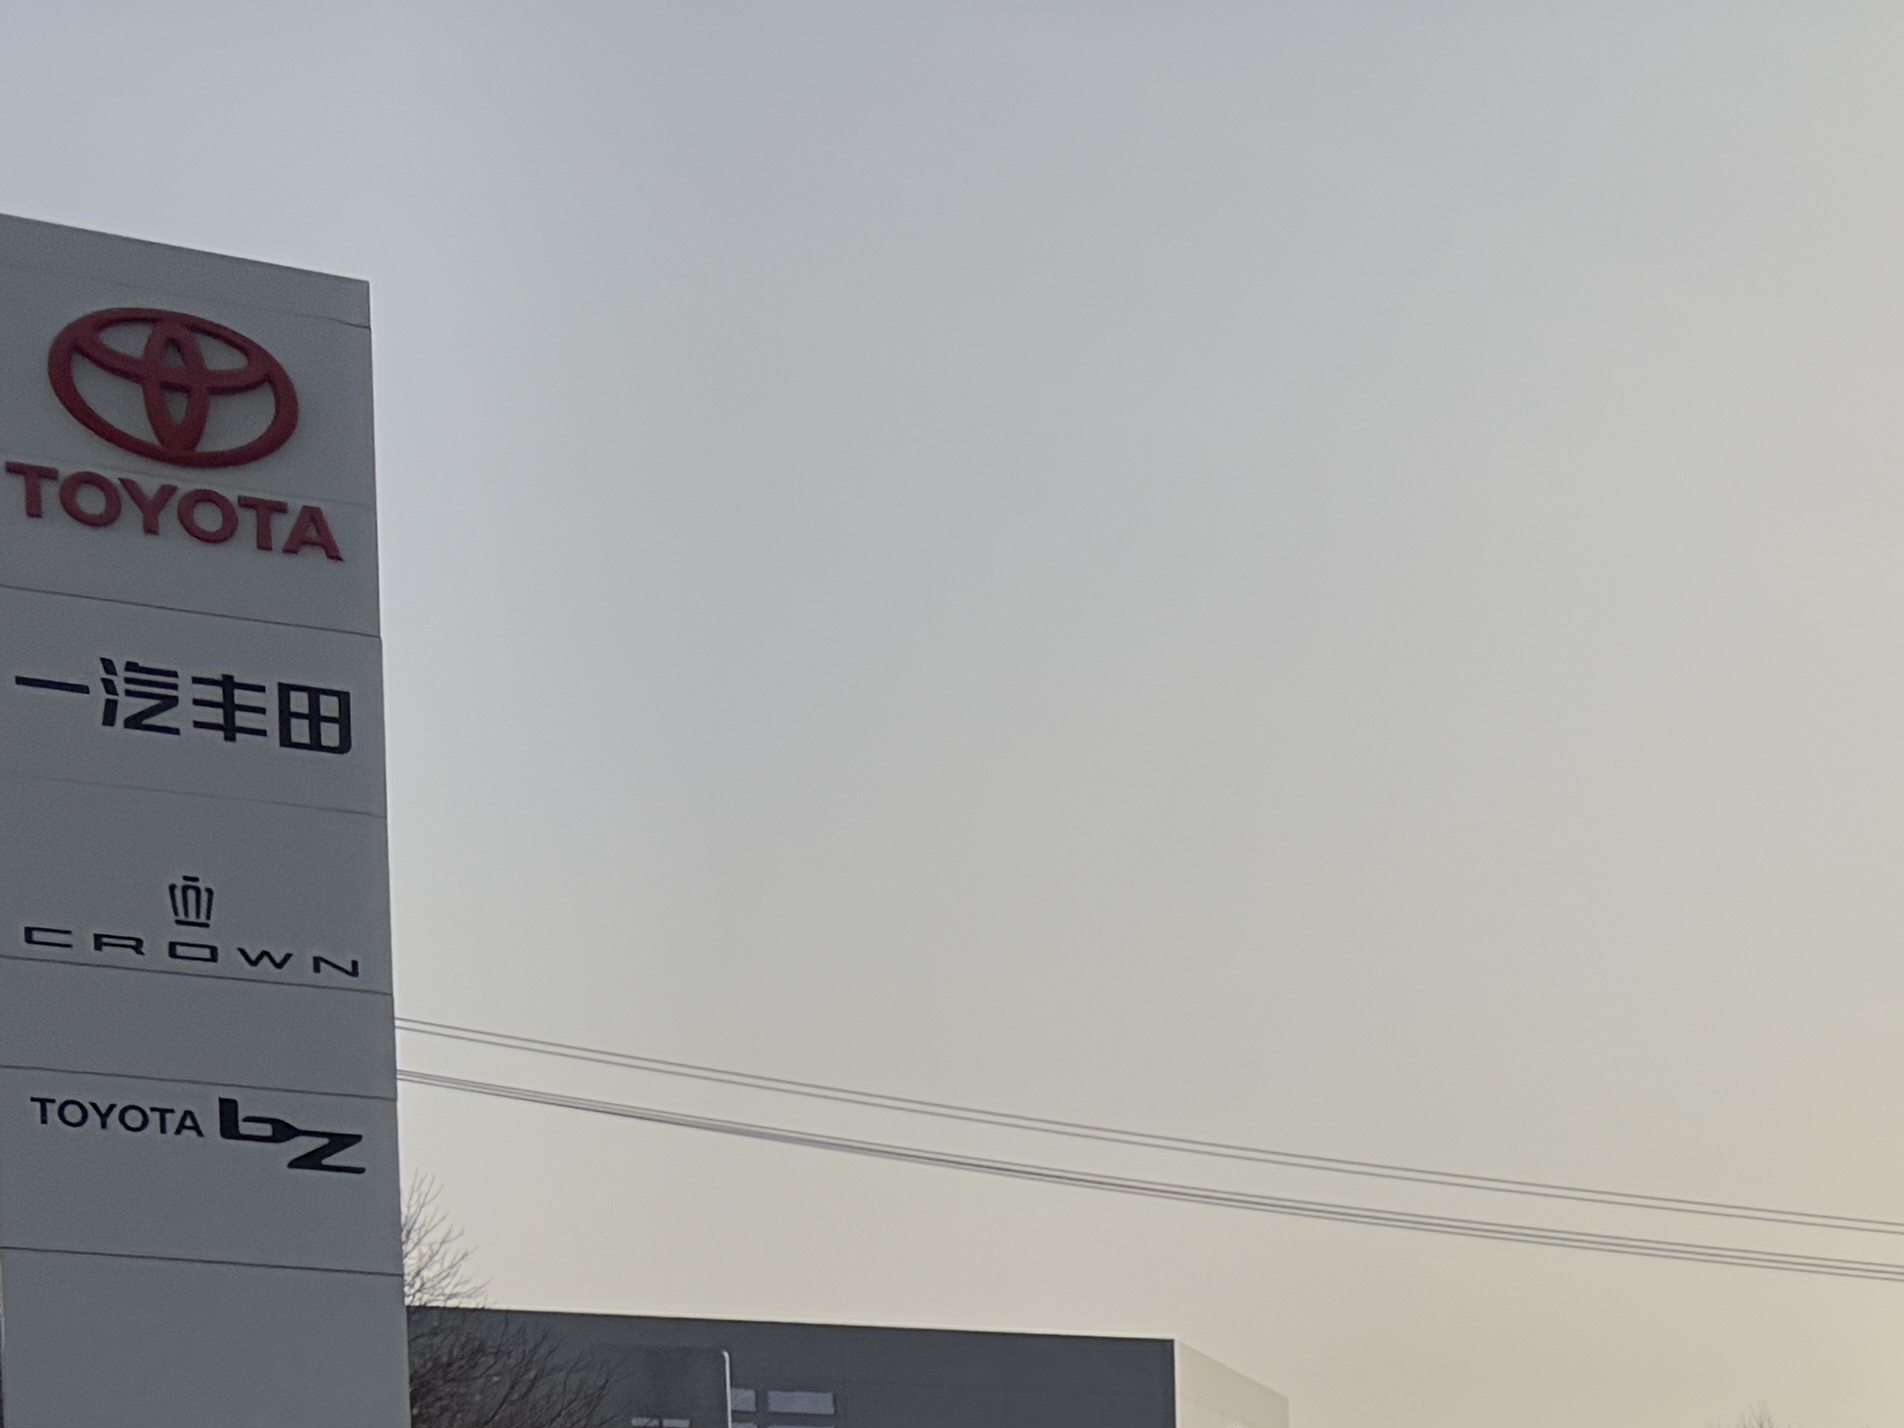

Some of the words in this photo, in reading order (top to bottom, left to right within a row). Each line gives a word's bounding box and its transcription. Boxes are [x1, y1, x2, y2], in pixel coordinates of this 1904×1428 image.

[4, 461, 344, 562] TOYOTA
[14, 656, 352, 755] 一汽丰田
[24, 926, 359, 978] CROWN
[30, 1096, 204, 1137] TOYOTA
